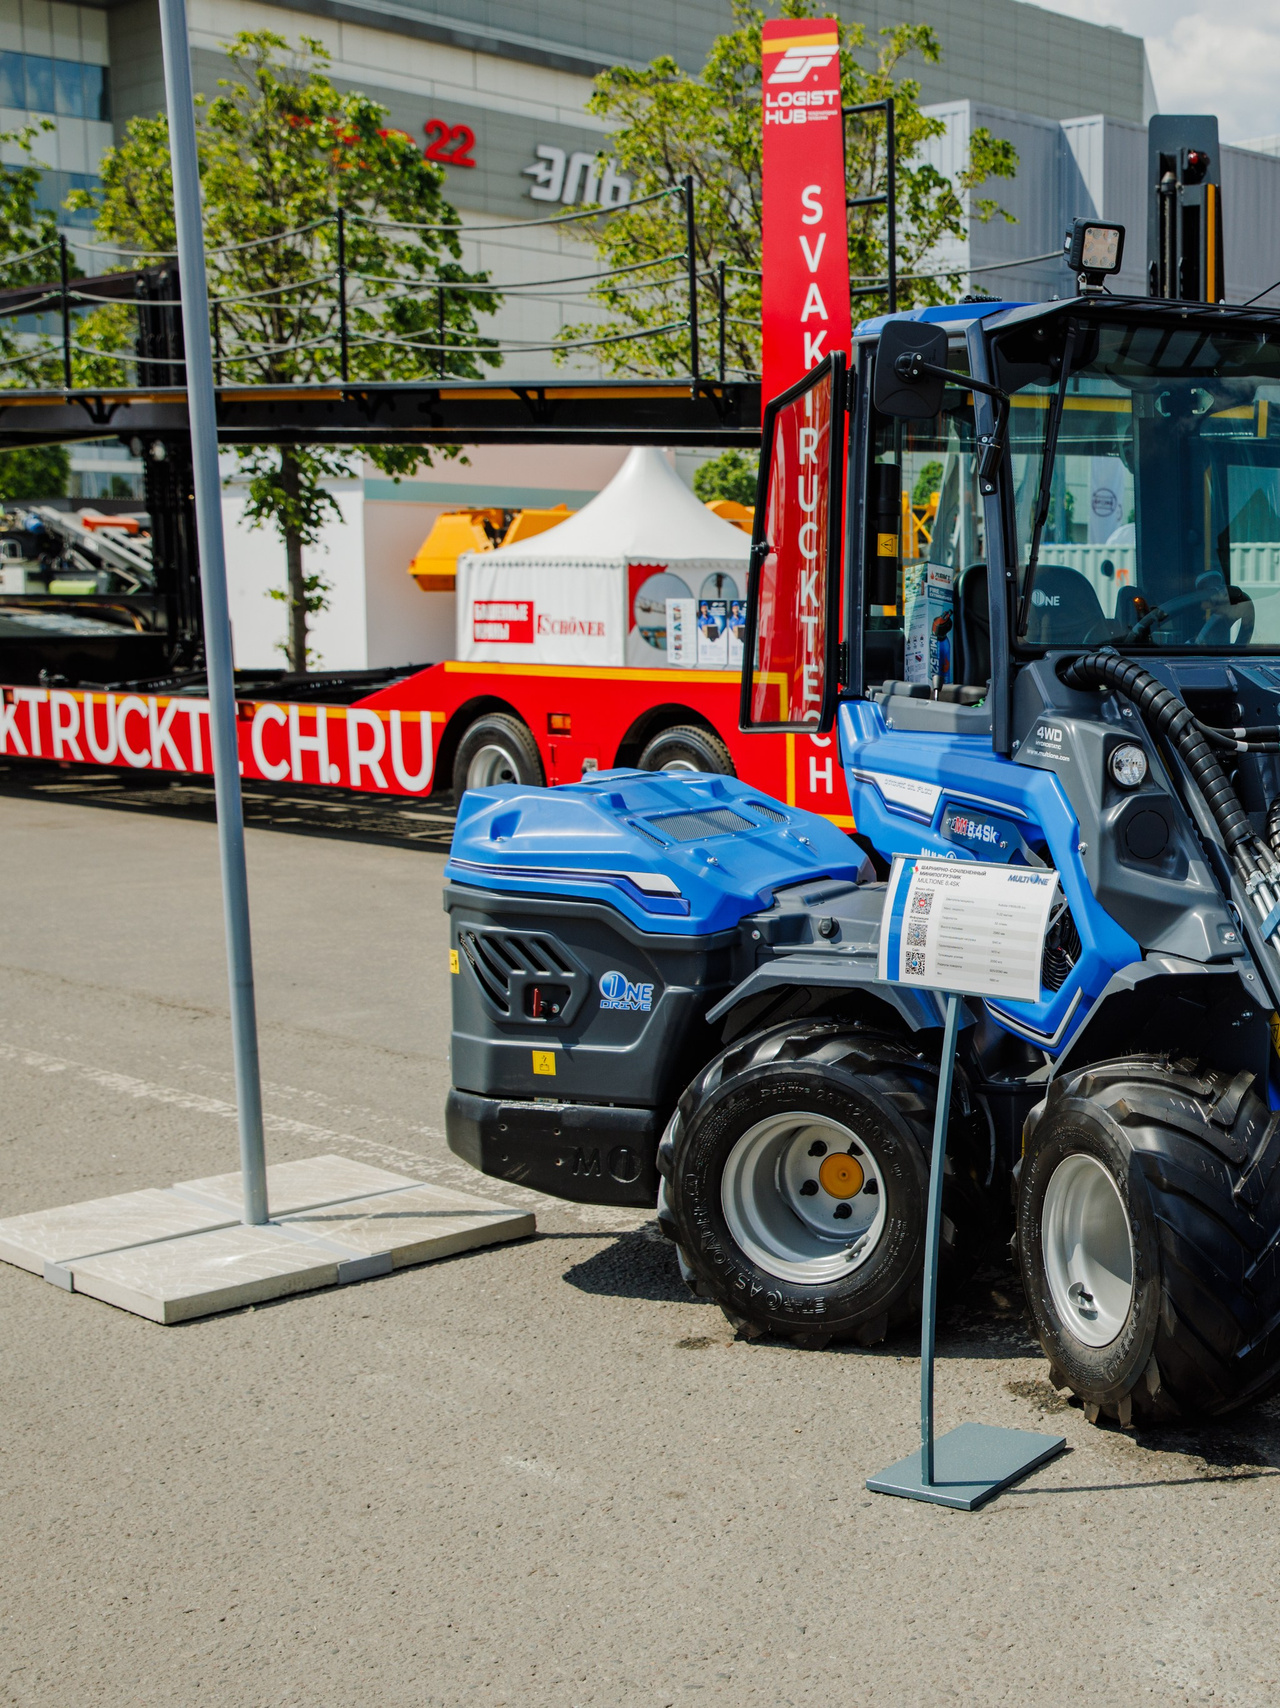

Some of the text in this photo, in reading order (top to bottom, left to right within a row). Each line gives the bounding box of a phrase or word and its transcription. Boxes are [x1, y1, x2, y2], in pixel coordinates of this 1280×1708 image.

[765, 90, 839, 107] LOGIST
[765, 108, 807, 125] HUB
[423, 117, 476, 168] 22
[0, 687, 433, 792] KTRUCKTCH.RU
[1036, 726, 1063, 742] 4WD
[1026, 748, 1070, 762] www.multione.com
[919, 871, 962, 881] МИНИПОГРУЗЧИК
[920, 865, 987, 877] ШАРНИРНО-СОЧЛЕНЕННЫЙ
[917, 877, 946, 887] MULTIONE
[1007, 873, 1051, 886] MULTIONE
[600, 1000, 652, 1012] DRIVE
